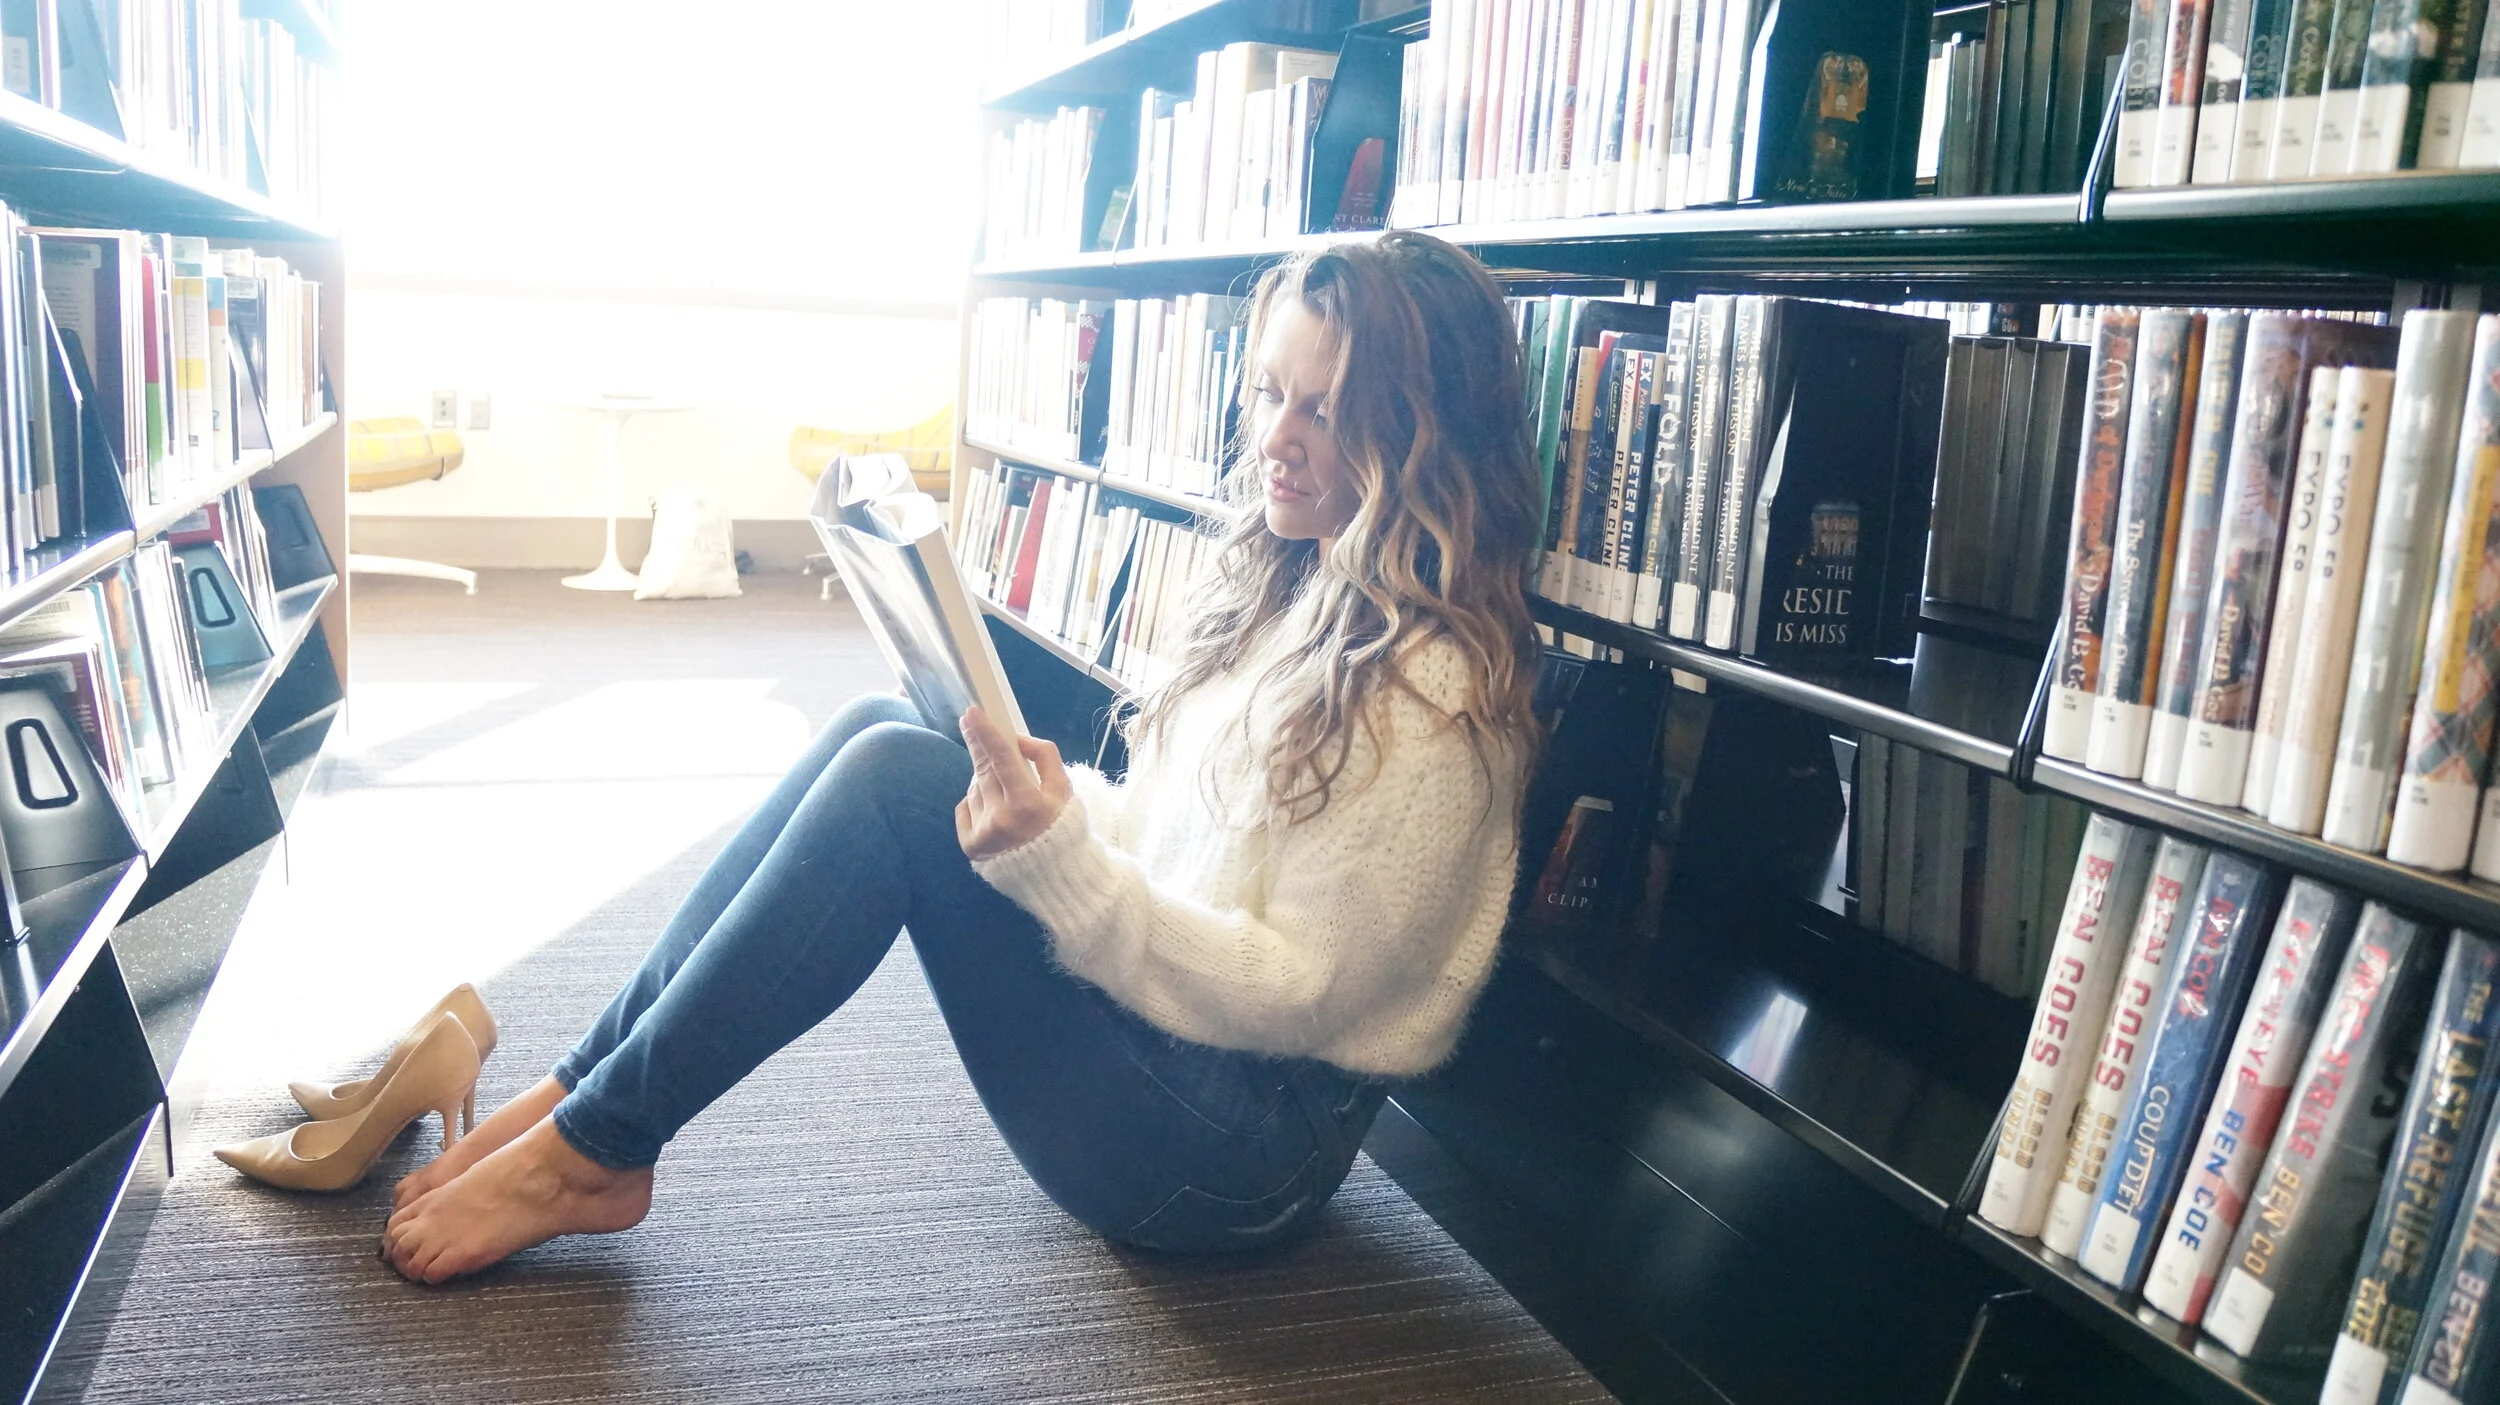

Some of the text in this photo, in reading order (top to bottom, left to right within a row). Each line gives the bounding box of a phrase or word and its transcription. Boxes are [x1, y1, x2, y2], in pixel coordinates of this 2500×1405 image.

[1626, 359, 1635, 380] EX
[1640, 358, 1653, 382] EX
[1689, 315, 1710, 451] JAMES PATTERSON
[1728, 316, 1750, 455] JAMES PATTERSON
[1654, 394, 1681, 488] FOLD
[1611, 450, 1624, 510] PETER
[1625, 452, 1641, 513] PETER
[1688, 494, 1705, 575] PRESIDENT
[1725, 500, 1742, 582] PRESIDENT
[1826, 565, 1853, 581] THE
[2075, 574, 2099, 634] David
[1776, 622, 1847, 644] IS MISS
[2031, 855, 2114, 1067] BEN COES
[2098, 875, 2183, 1091] BEN COES
[2134, 1084, 2170, 1158] COUP
[2179, 1109, 2244, 1251] BEN COE
[2262, 1166, 2300, 1228] BEN
